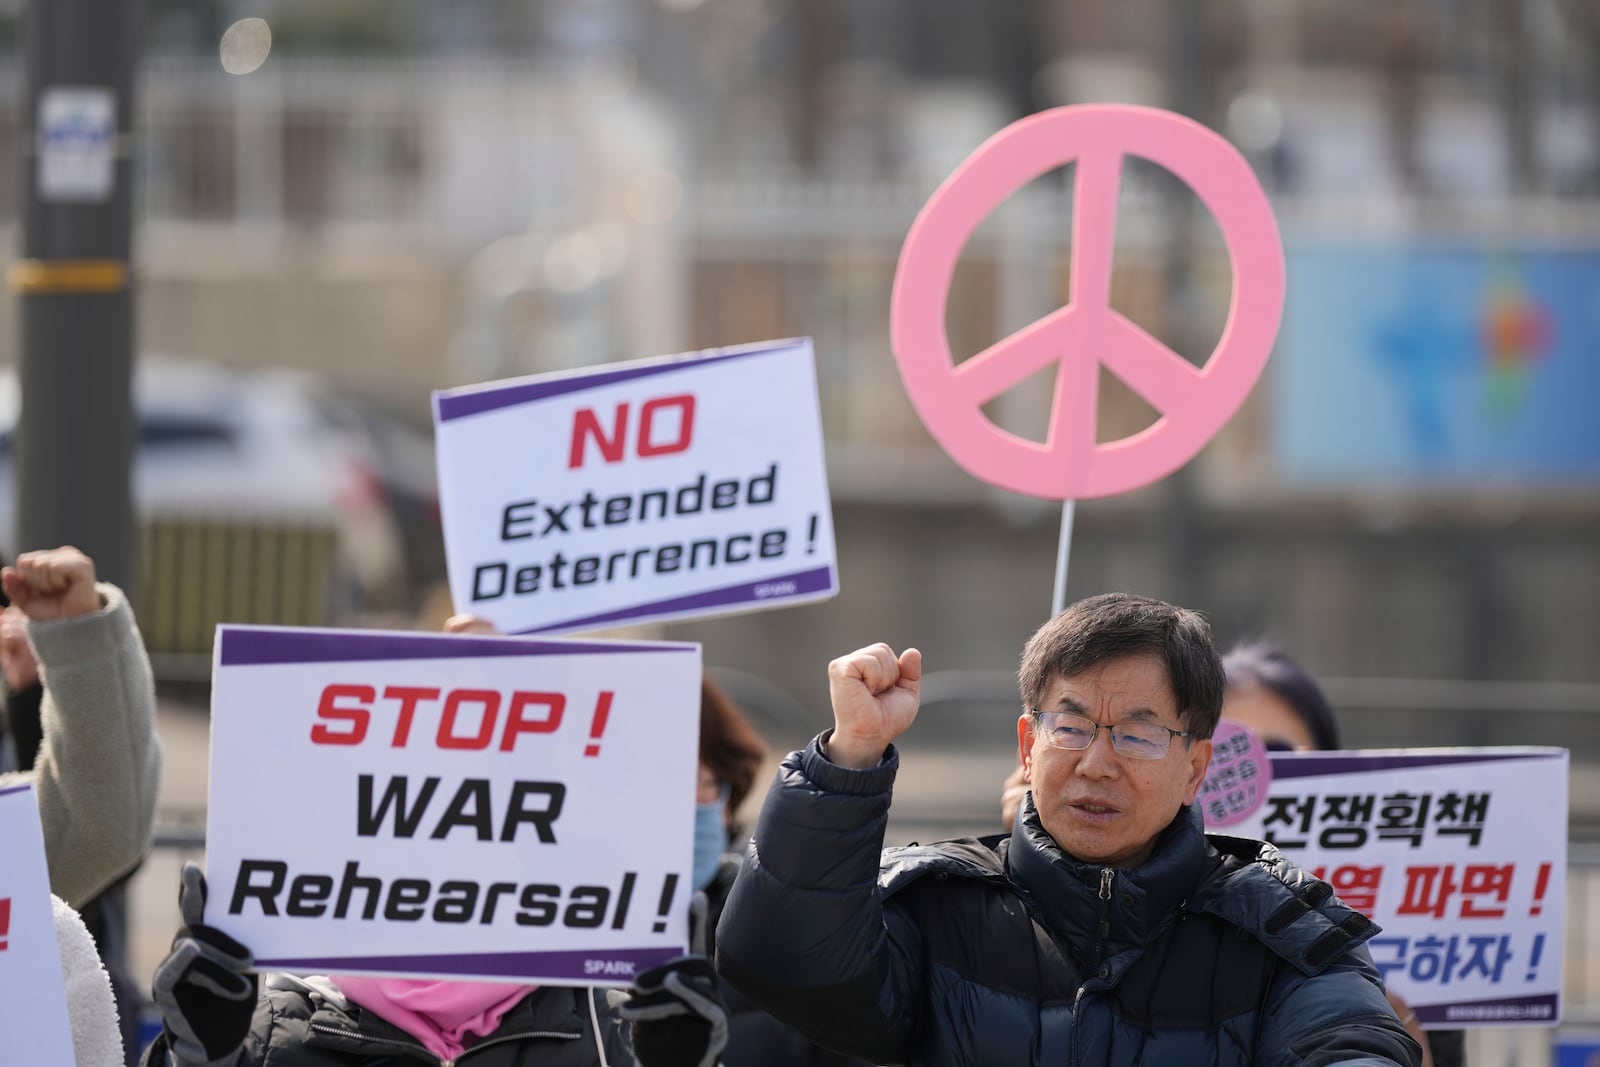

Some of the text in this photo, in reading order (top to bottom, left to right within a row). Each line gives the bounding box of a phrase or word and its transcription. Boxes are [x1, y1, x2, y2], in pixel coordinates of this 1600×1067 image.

[569, 394, 696, 470] NO
[501, 464, 779, 542] Extended
[471, 513, 820, 602] Deterrence !
[310, 683, 615, 758] STOP !
[357, 774, 567, 844] WAR
[1261, 790, 1491, 849] 전쟁획책
[228, 859, 680, 933] Rehearsal !
[1310, 863, 1552, 920] 열 파면 !
[584, 960, 635, 976] SPARK
[1525, 932, 1547, 983] !
